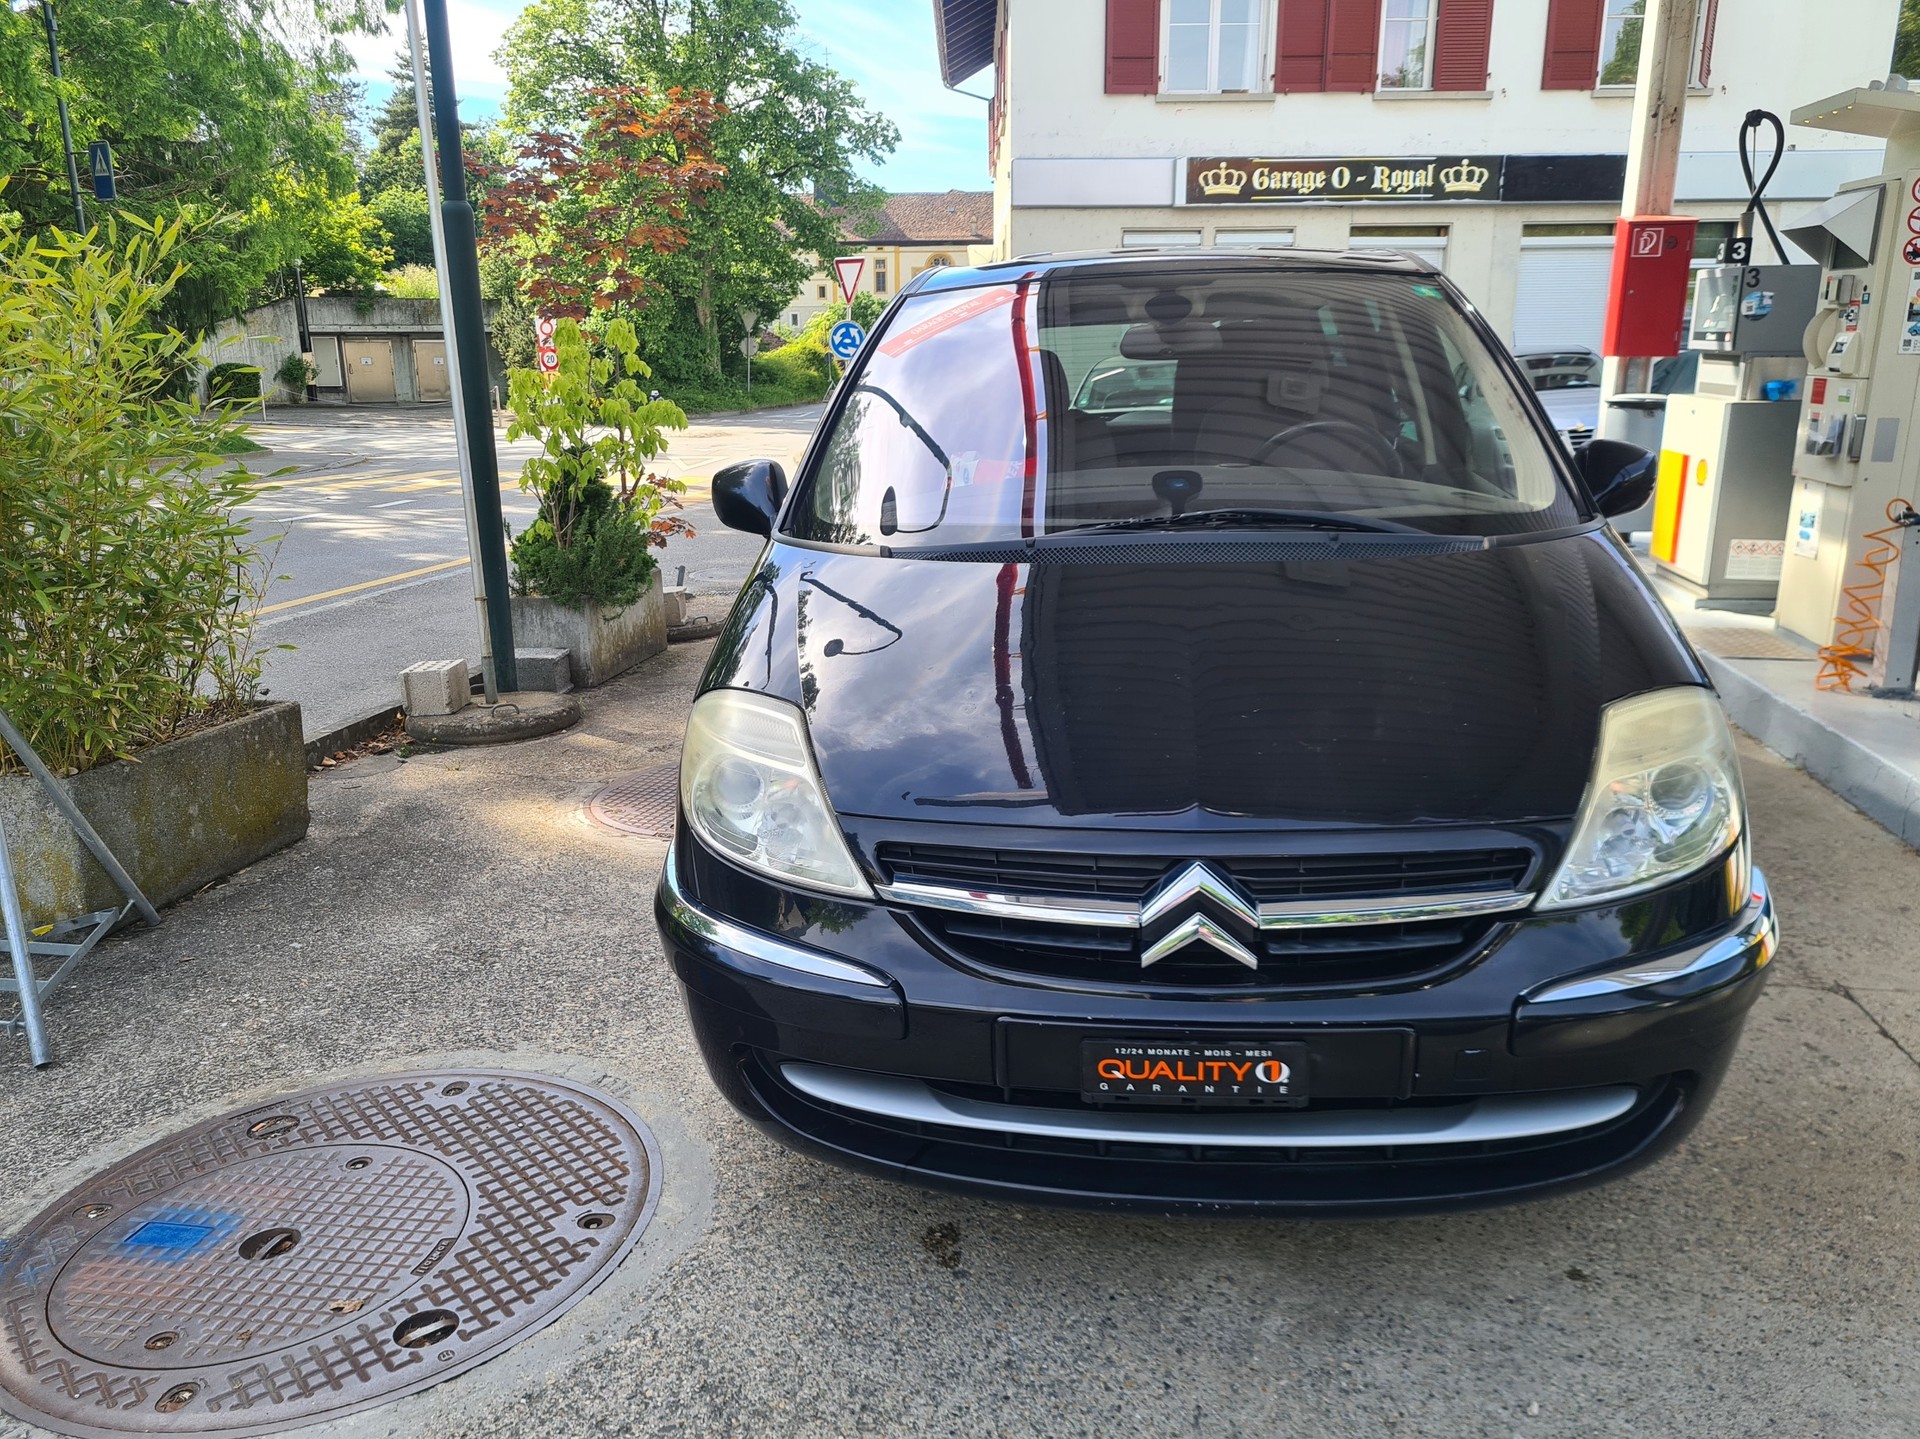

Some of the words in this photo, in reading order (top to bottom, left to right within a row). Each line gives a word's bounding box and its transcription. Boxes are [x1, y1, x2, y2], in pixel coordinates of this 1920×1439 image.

[1252, 166, 1326, 194] Garage
[1331, 166, 1350, 189] O
[1370, 163, 1436, 193] Royal
[1731, 242, 1746, 260] 3
[1746, 268, 1760, 288] 3
[545, 354, 555, 364] 20
[1114, 1047, 1143, 1055] 12/24
[1147, 1048, 1191, 1056] MONATE
[1204, 1049, 1232, 1057] MOIS
[1245, 1049, 1273, 1057] MESI
[1097, 1058, 1253, 1082] QUALITY
[1100, 1082, 1288, 1094] GARANTIE
